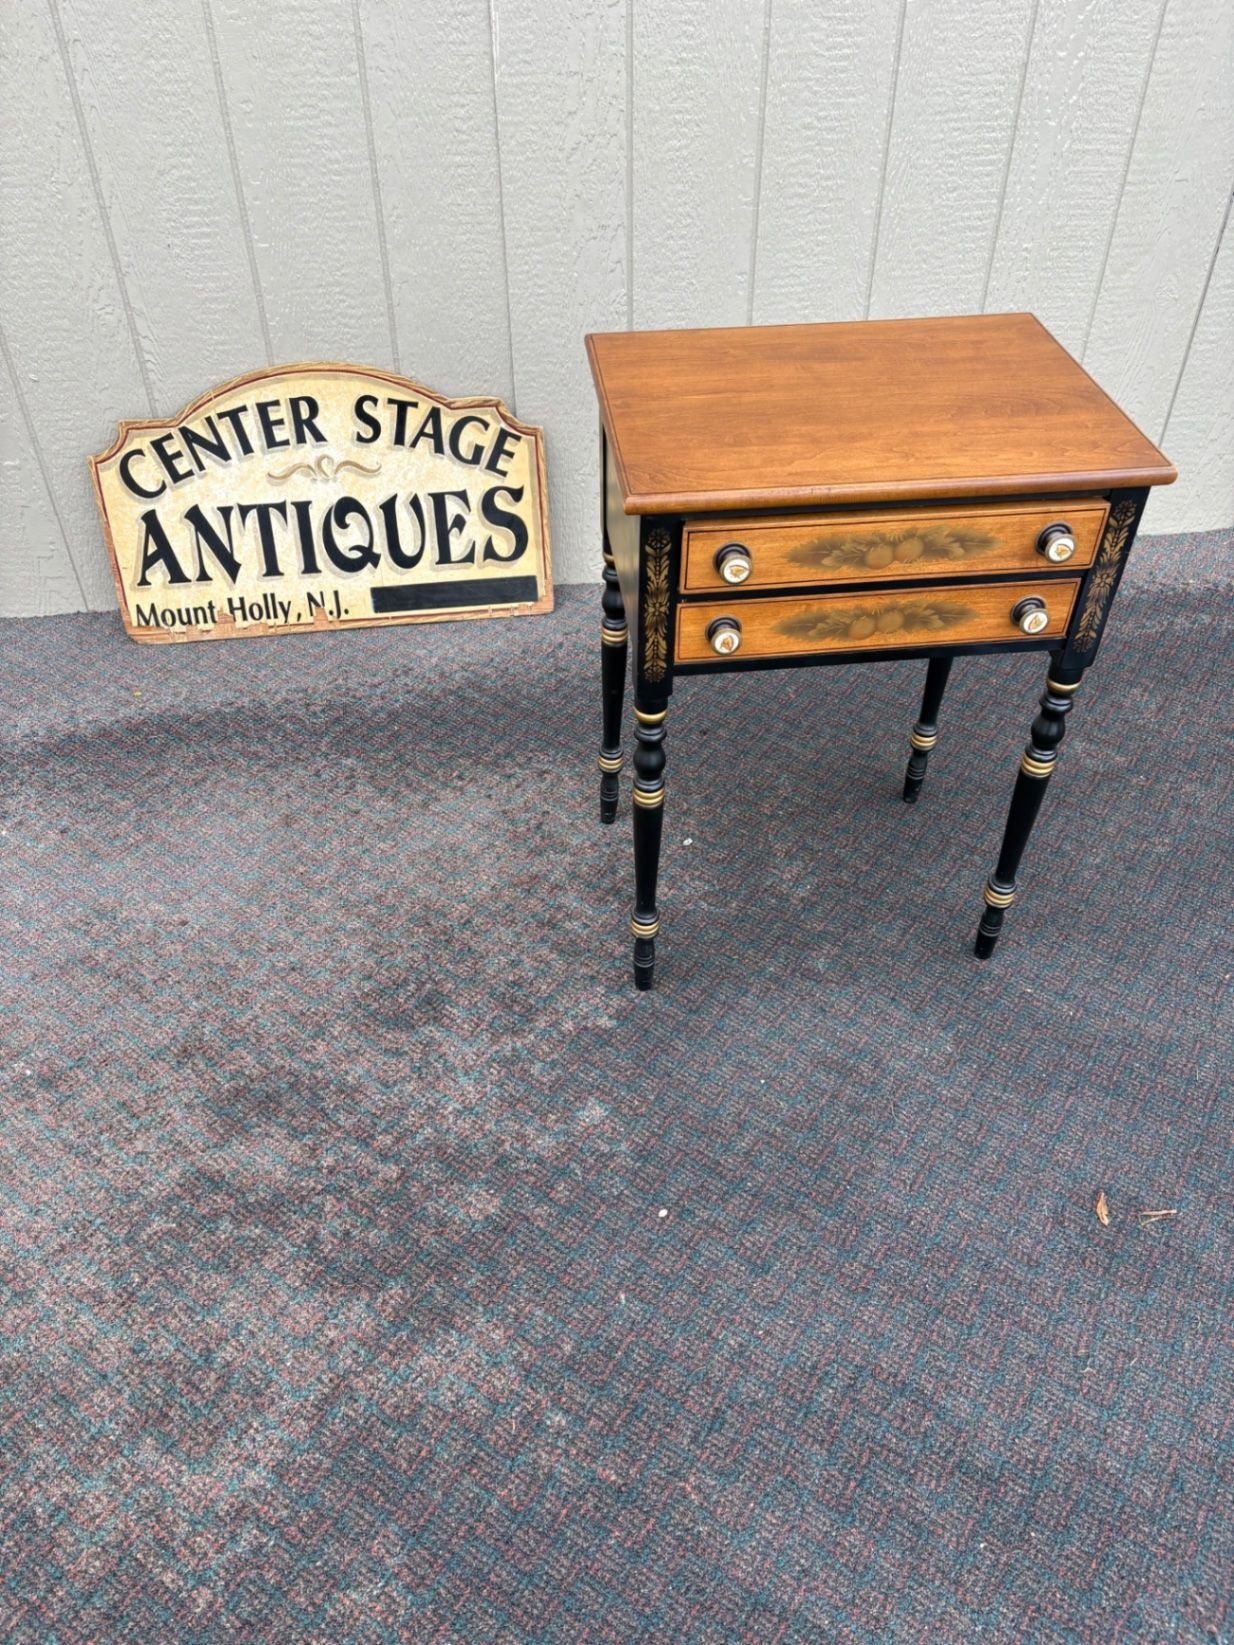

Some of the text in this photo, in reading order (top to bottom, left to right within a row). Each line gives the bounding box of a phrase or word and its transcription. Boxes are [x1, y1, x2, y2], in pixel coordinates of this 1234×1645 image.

[118, 394, 522, 499] CENTER STAGE
[137, 485, 529, 587] ANTIQUES
[135, 589, 350, 628] Mount Holly, N.J.
